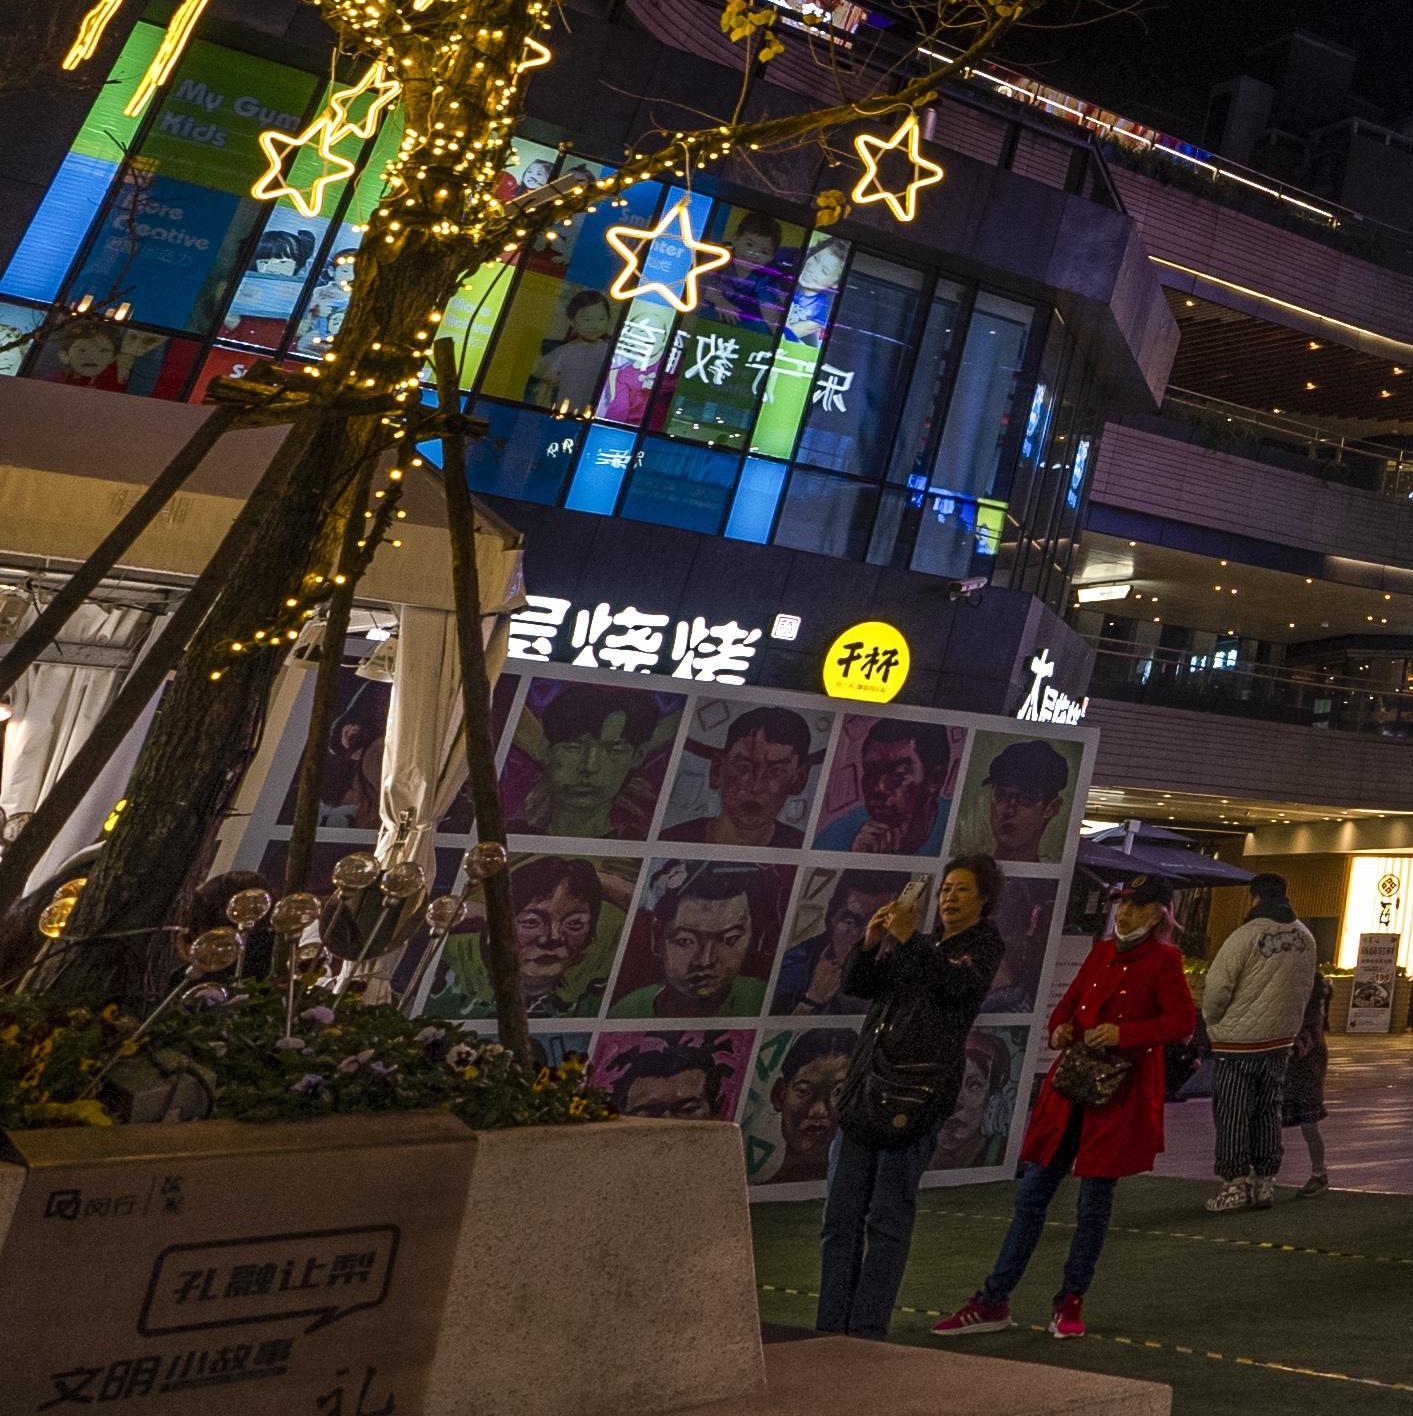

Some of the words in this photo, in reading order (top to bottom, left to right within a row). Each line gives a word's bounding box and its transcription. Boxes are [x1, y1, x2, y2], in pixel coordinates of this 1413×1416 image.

[159, 111, 227, 147] Kids
[176, 78, 224, 112] My
[234, 96, 301, 132] Gym
[837, 642, 900, 683] 干杯
[173, 1250, 378, 1304] 孔融让梨
[37, 1338, 296, 1411] 文明小故事
